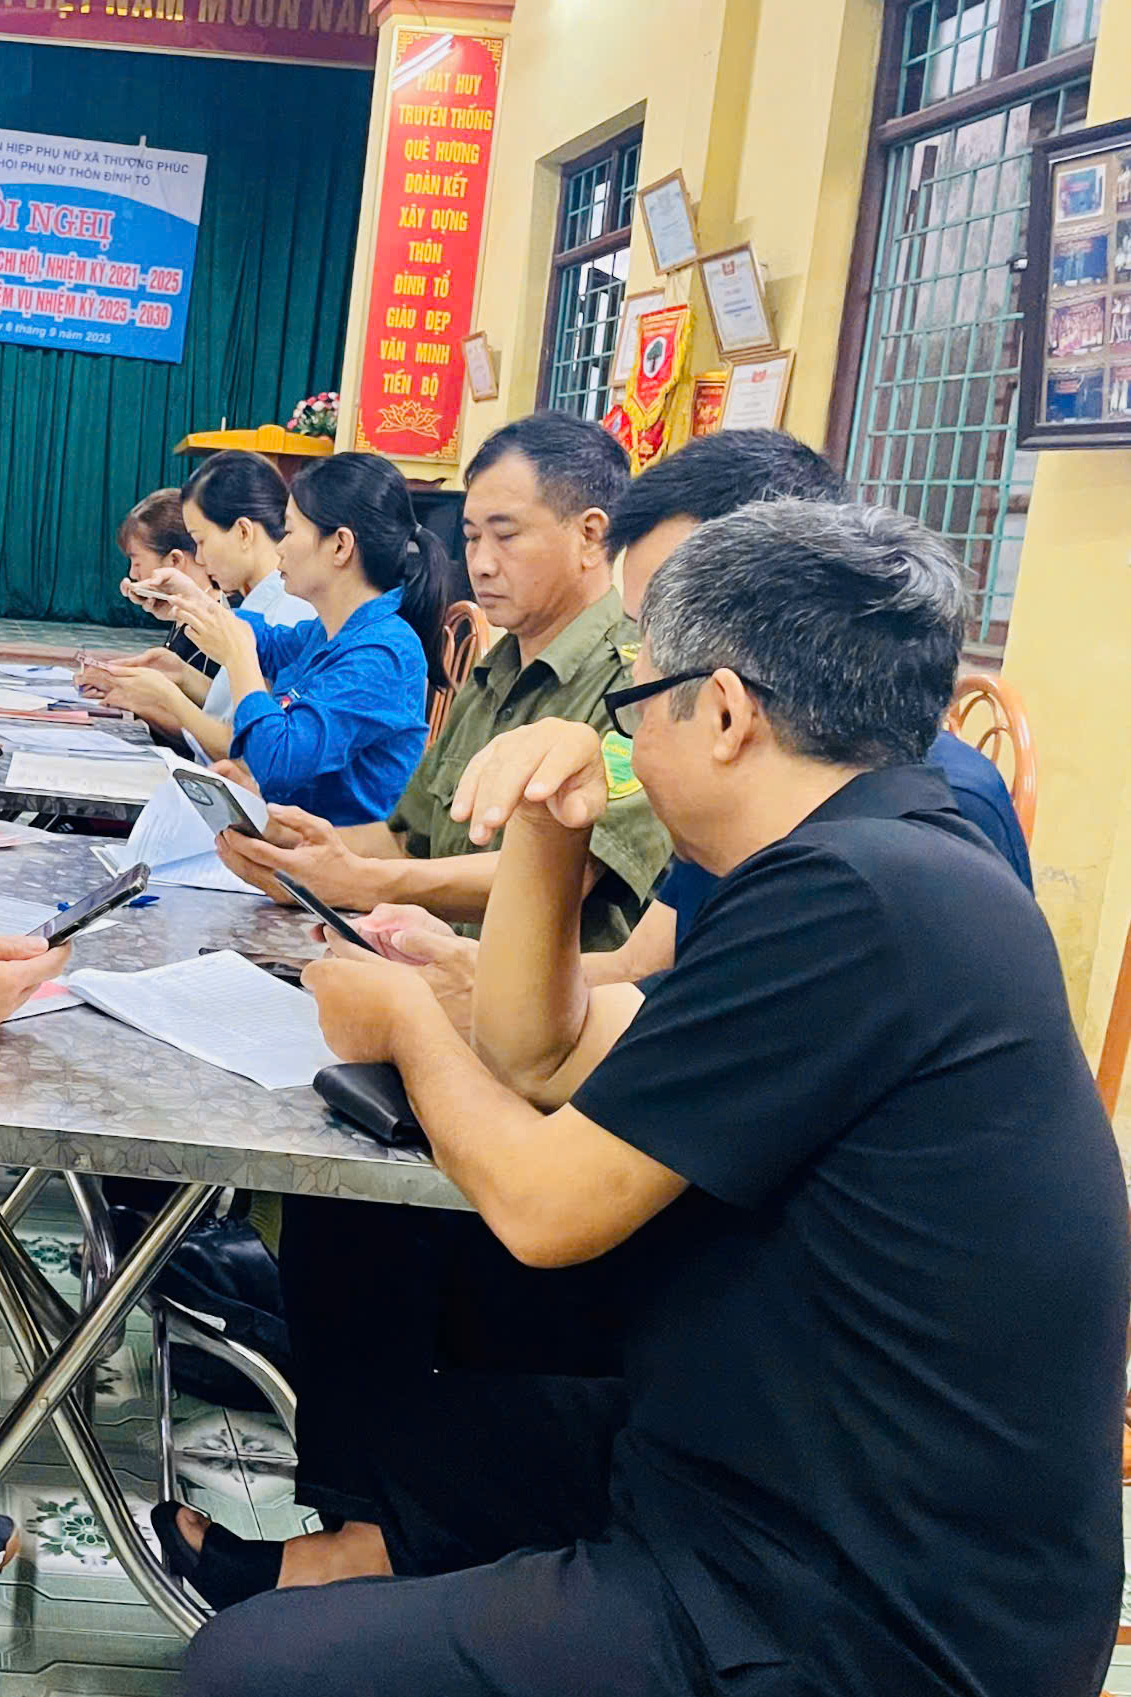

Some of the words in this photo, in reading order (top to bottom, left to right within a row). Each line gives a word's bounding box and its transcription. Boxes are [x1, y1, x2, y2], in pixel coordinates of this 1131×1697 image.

[455, 73, 483, 96] HUY
[451, 103, 494, 131] THỐNG
[36, 146, 61, 159] PHỤ
[63, 148, 82, 160] NỮ
[84, 150, 100, 163] XÃ
[102, 154, 154, 170] THƯỢNG
[156, 160, 190, 174] PHÚC
[404, 136, 431, 162] QUÊ
[435, 140, 481, 165] HƯƠNG
[20, 161, 45, 174] PHỤ
[48, 164, 67, 176] NỮ
[69, 166, 101, 180] THÔN
[104, 170, 132, 184] ĐÌNH
[443, 170, 469, 198] KẾT
[28, 201, 114, 249] NGHỊ
[398, 203, 426, 228] XÂY
[431, 208, 469, 235] DỰNG
[408, 238, 443, 264] THÔN
[46, 253, 87, 285] NHIỆM
[89, 256, 107, 283] KỲ
[109, 265, 138, 287] 2021
[149, 269, 180, 292] 2025
[433, 269, 452, 298] TỔ
[18, 287, 33, 316] VỤ
[36, 287, 76, 319] NHIỆM
[78, 292, 95, 317] KỲ
[97, 298, 128, 322] 2025
[138, 304, 170, 327] 2030
[385, 303, 417, 330] GIÀU
[424, 309, 451, 336] ĐẸP
[85, 331, 112, 345] 2025
[380, 336, 407, 361] VĂN
[415, 342, 451, 365] MINH
[383, 368, 412, 395] TIẾN
[420, 372, 440, 401] BỘ
